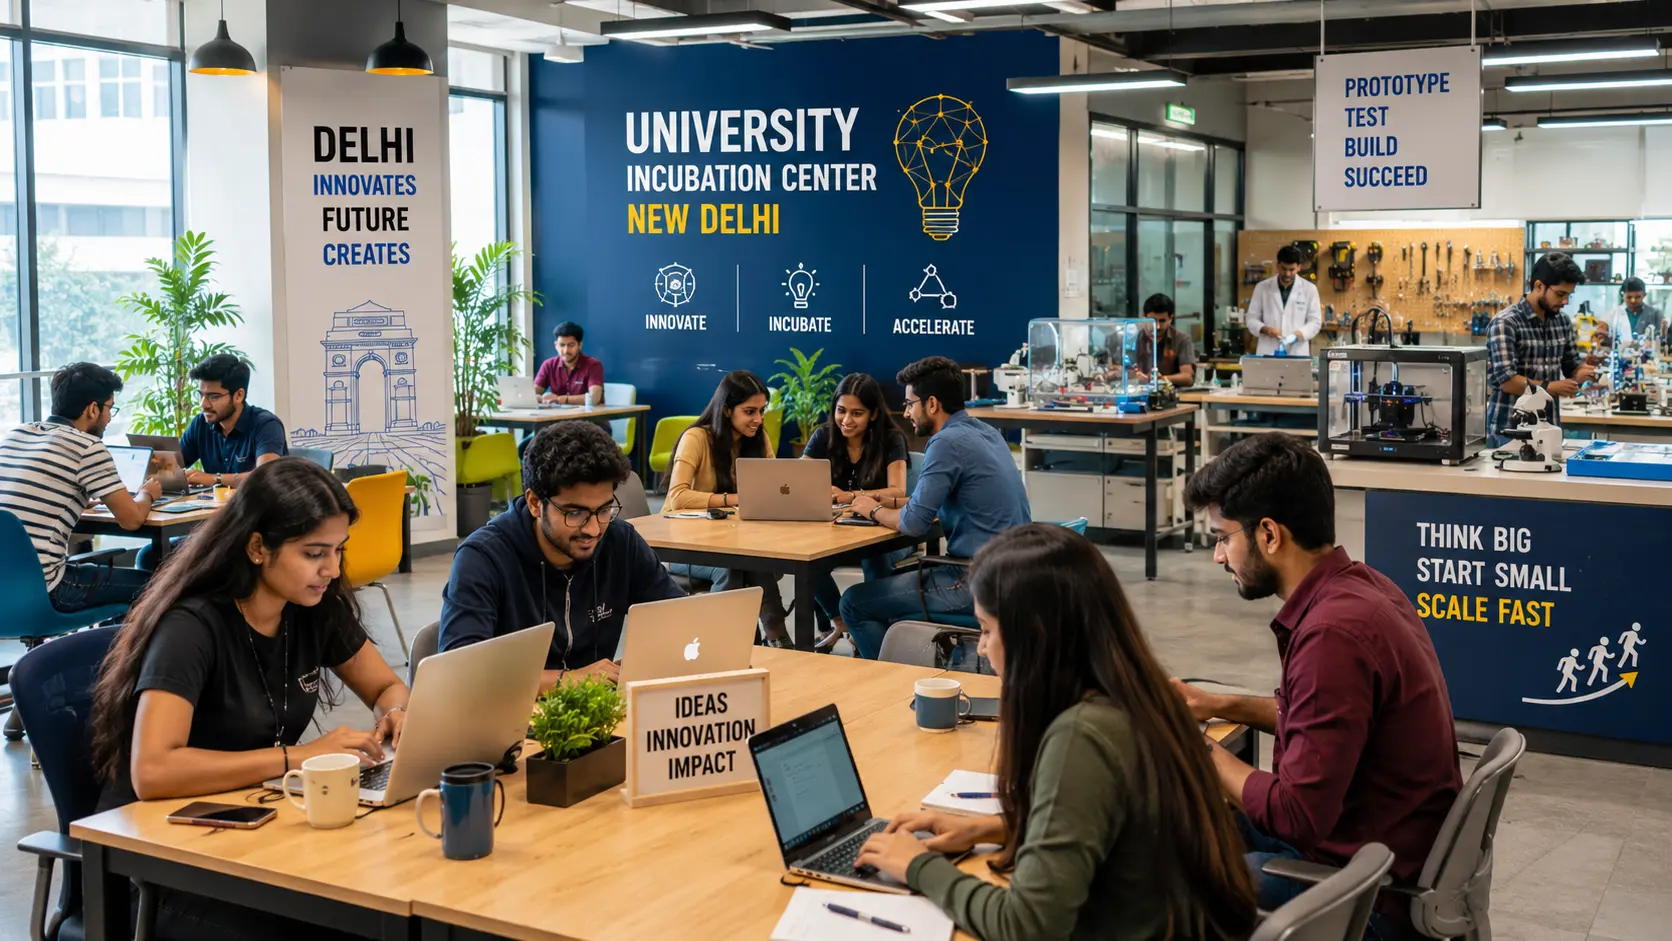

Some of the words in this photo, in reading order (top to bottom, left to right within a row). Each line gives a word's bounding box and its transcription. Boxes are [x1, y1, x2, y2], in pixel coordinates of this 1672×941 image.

[1344, 71, 1450, 98] PROTOTYPE
[1344, 105, 1390, 128] TEST
[314, 126, 413, 163] DELHI
[625, 107, 860, 155] UNIVERSITY
[1344, 135, 1398, 158] BUILD
[313, 173, 417, 196] INNOVATES
[626, 163, 771, 192] INCUBATION
[781, 163, 877, 192] CENTER
[1343, 165, 1428, 188] SUCCEED
[322, 206, 410, 232] FUTURE
[627, 203, 690, 234] NEW
[700, 203, 780, 234] DELHI
[323, 242, 411, 266] CREATES
[645, 313, 707, 331] INNOVATE
[769, 315, 832, 333] INCUBATE
[892, 318, 975, 336] ACCELERATE
[1416, 522, 1484, 551] THINK
[1494, 526, 1532, 554] BIG
[1416, 557, 1486, 586] START
[1494, 562, 1572, 593] SMALL
[1416, 592, 1489, 623] SCALE
[1498, 598, 1556, 628] FAST
[675, 692, 728, 719] IDEAS
[646, 718, 756, 753] INNOVATION
[668, 750, 737, 781] IMPACT
